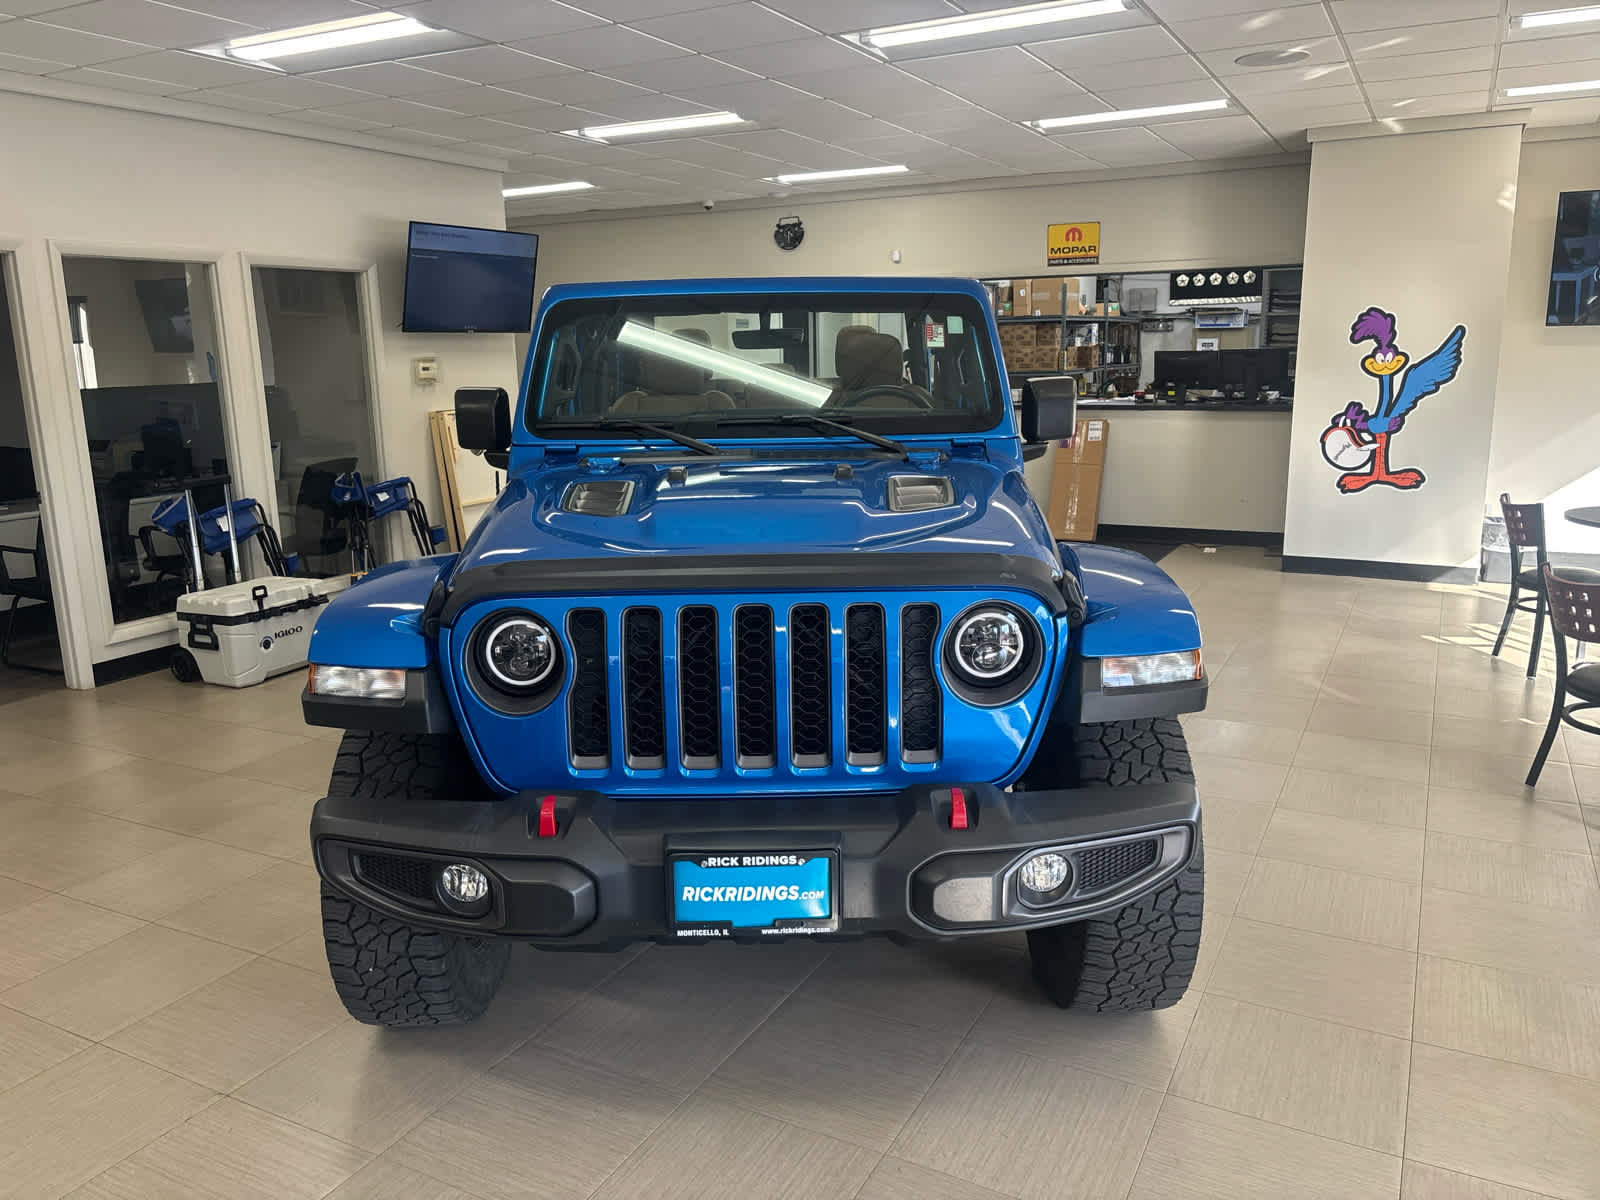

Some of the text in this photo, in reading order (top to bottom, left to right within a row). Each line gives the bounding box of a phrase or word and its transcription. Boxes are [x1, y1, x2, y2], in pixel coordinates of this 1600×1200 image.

[1050, 246, 1096, 254] MOPAR
[274, 626, 303, 639] IGLOO
[707, 855, 797, 867] RICK RIDINGS
[761, 927, 831, 935] www.rickridings.com
